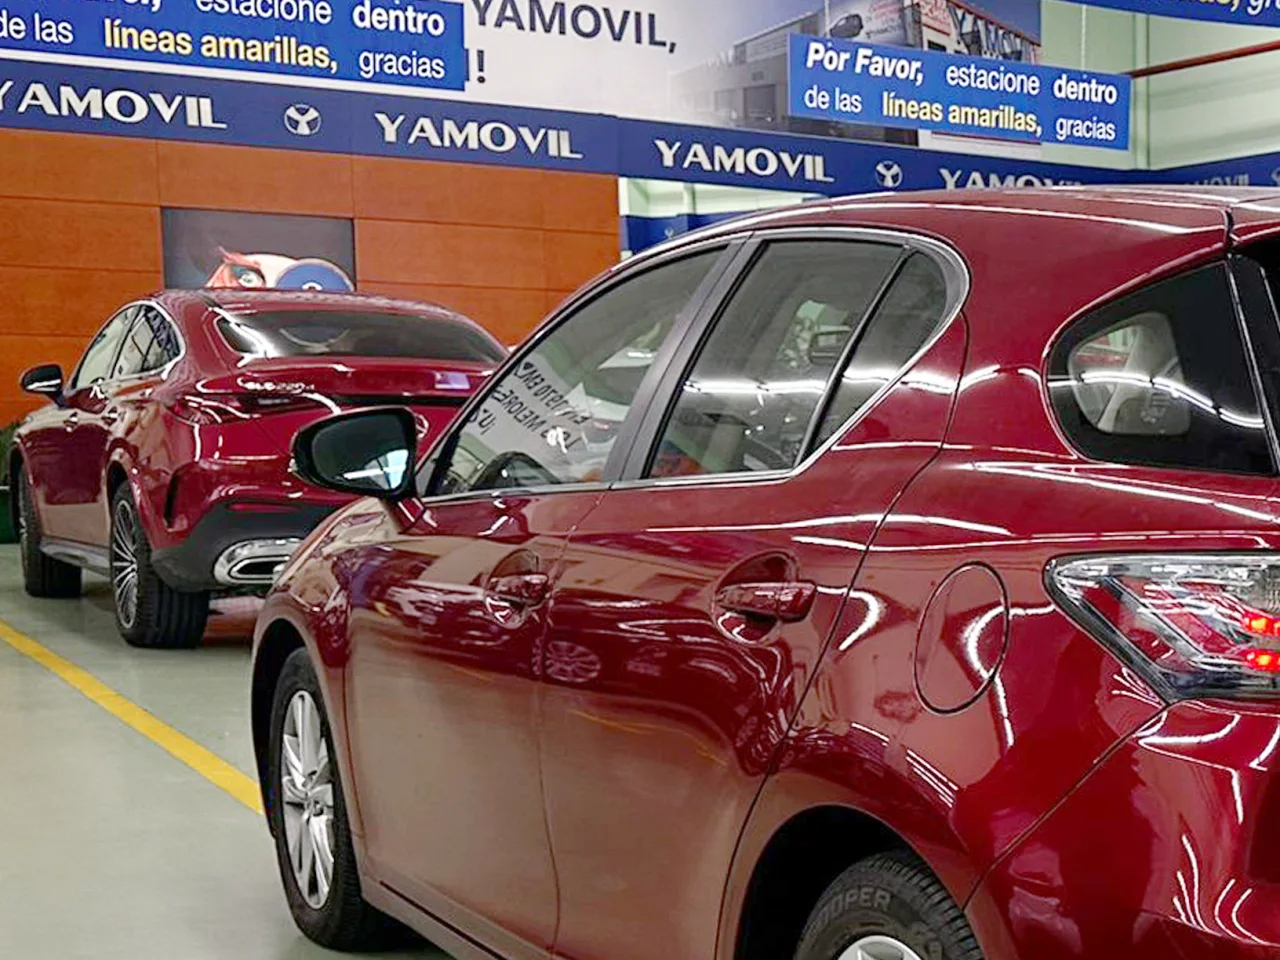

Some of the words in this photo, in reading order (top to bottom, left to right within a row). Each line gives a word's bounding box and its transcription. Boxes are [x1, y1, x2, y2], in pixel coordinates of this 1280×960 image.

[35, 12, 74, 44] las
[104, 17, 193, 55] líneas
[200, 34, 338, 74] amarillas,
[359, 49, 446, 79] gracias
[352, 1, 446, 36] dentro
[472, 0, 677, 54] YAMOVIL,
[806, 42, 850, 72] Por
[855, 48, 924, 86] Favor,
[946, 65, 1040, 95] estacione
[1053, 73, 1118, 104] dentro
[374, 112, 583, 159] YAMOVIL
[804, 85, 829, 109] de
[834, 88, 862, 113] las
[882, 91, 943, 122] líneas
[948, 105, 1042, 137] amarillas,
[1056, 116, 1116, 141] gracias
[653, 139, 834, 183] YAMOVIL
